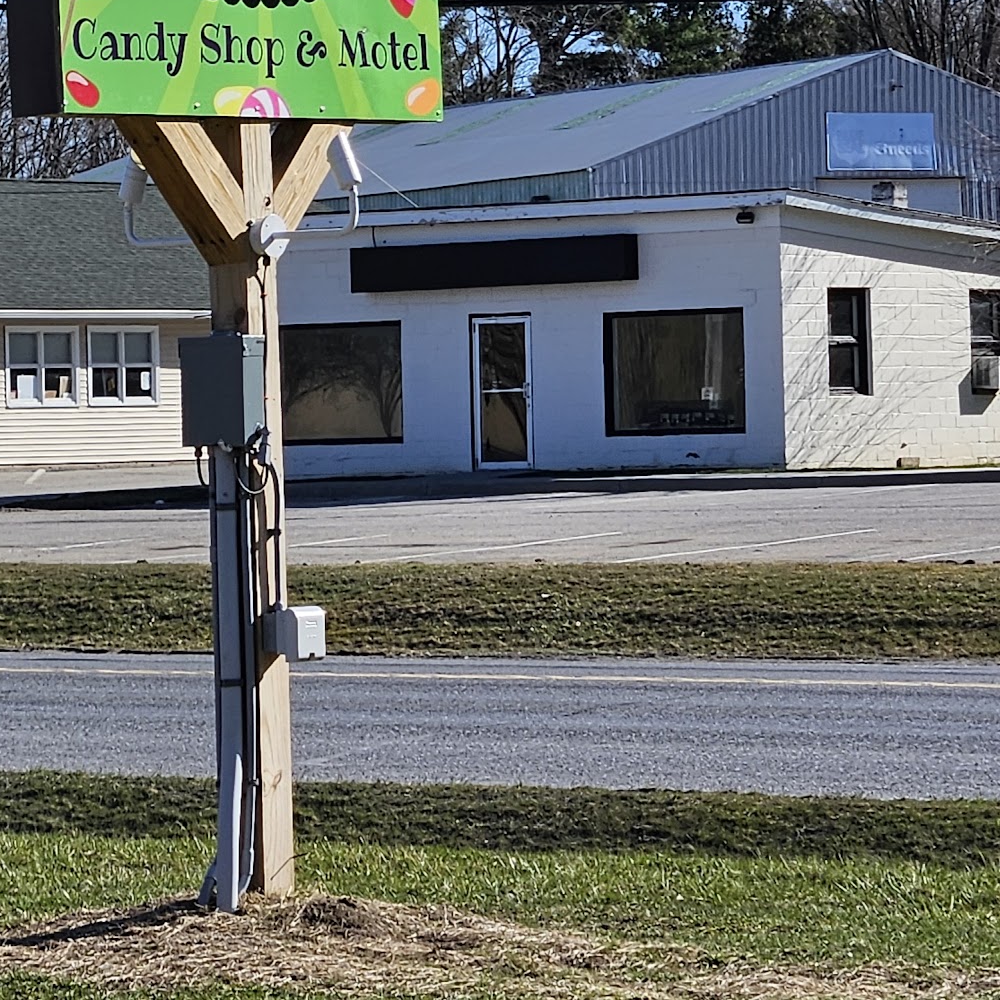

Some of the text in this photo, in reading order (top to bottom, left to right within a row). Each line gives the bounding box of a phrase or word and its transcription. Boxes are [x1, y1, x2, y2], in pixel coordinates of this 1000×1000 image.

[72, 17, 431, 79] Candy Shop & Motel
